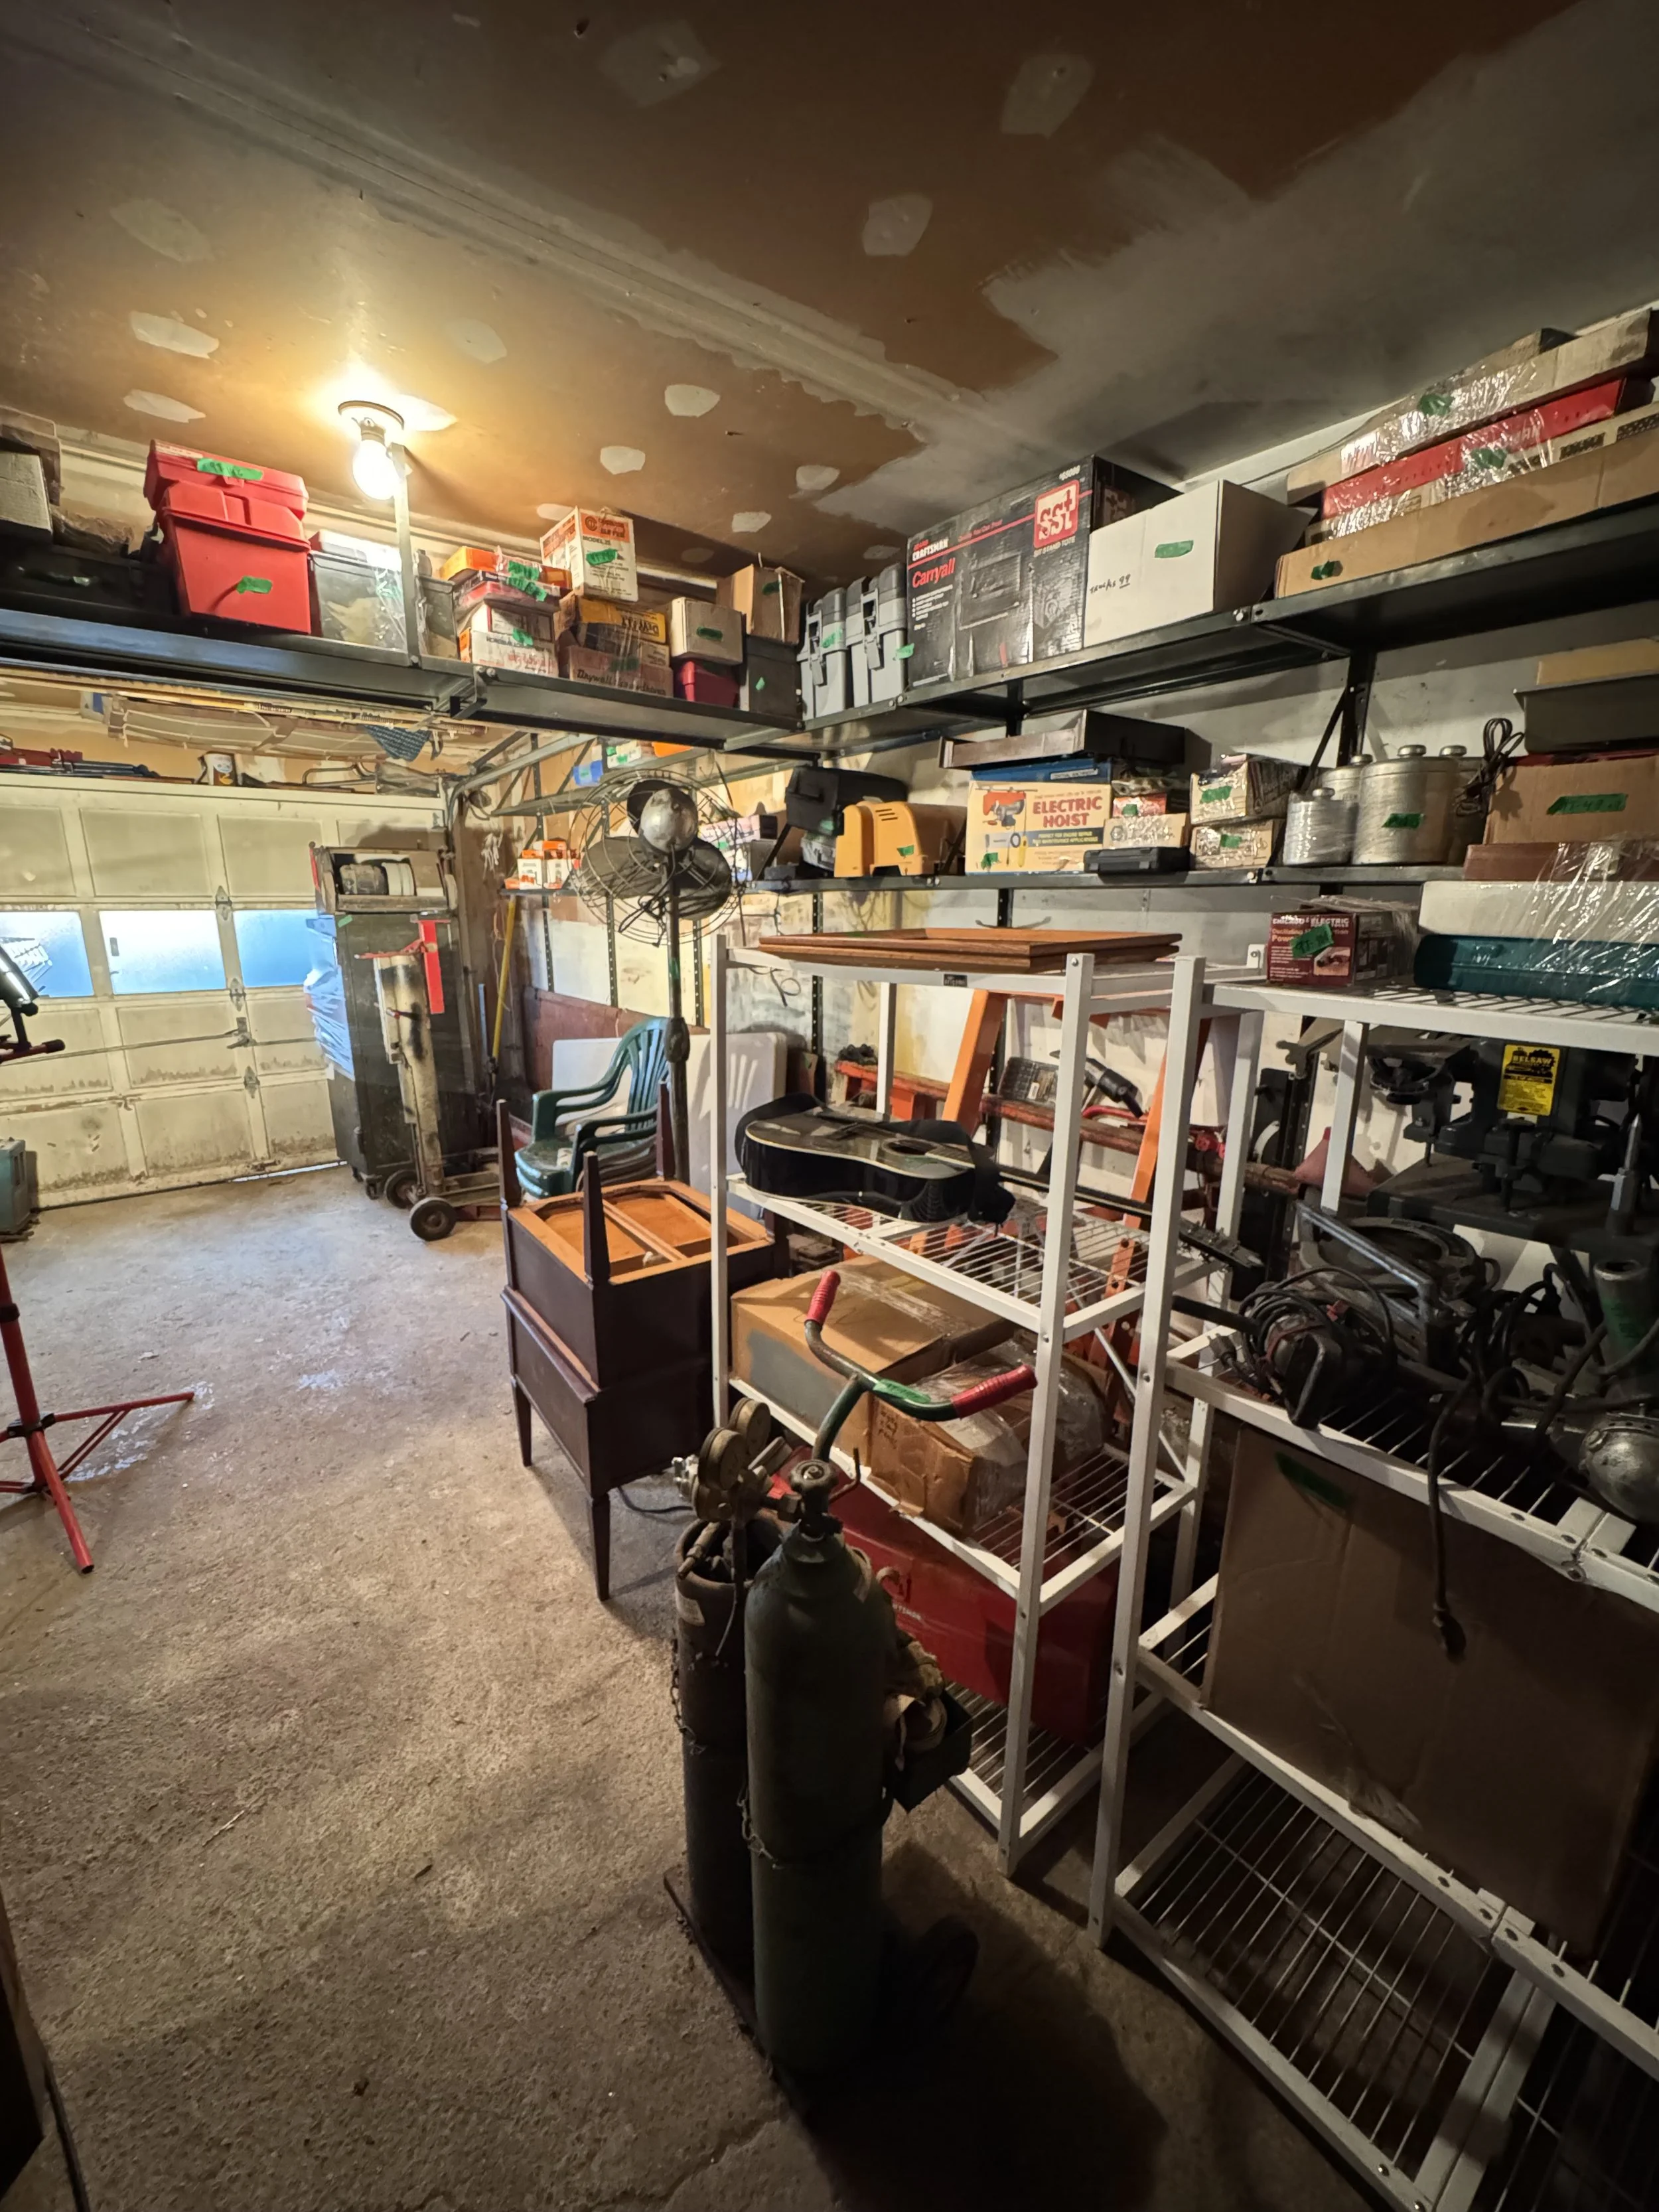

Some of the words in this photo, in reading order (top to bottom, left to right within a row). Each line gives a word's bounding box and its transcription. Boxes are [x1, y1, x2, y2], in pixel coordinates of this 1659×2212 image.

[912, 536, 949, 561] CRAFTSMAN
[912, 557, 956, 588] Carryall
[1033, 796, 1103, 814] ELECTRIC
[1043, 812, 1090, 828] HOIST
[1512, 1055, 1552, 1065] BELSAW
